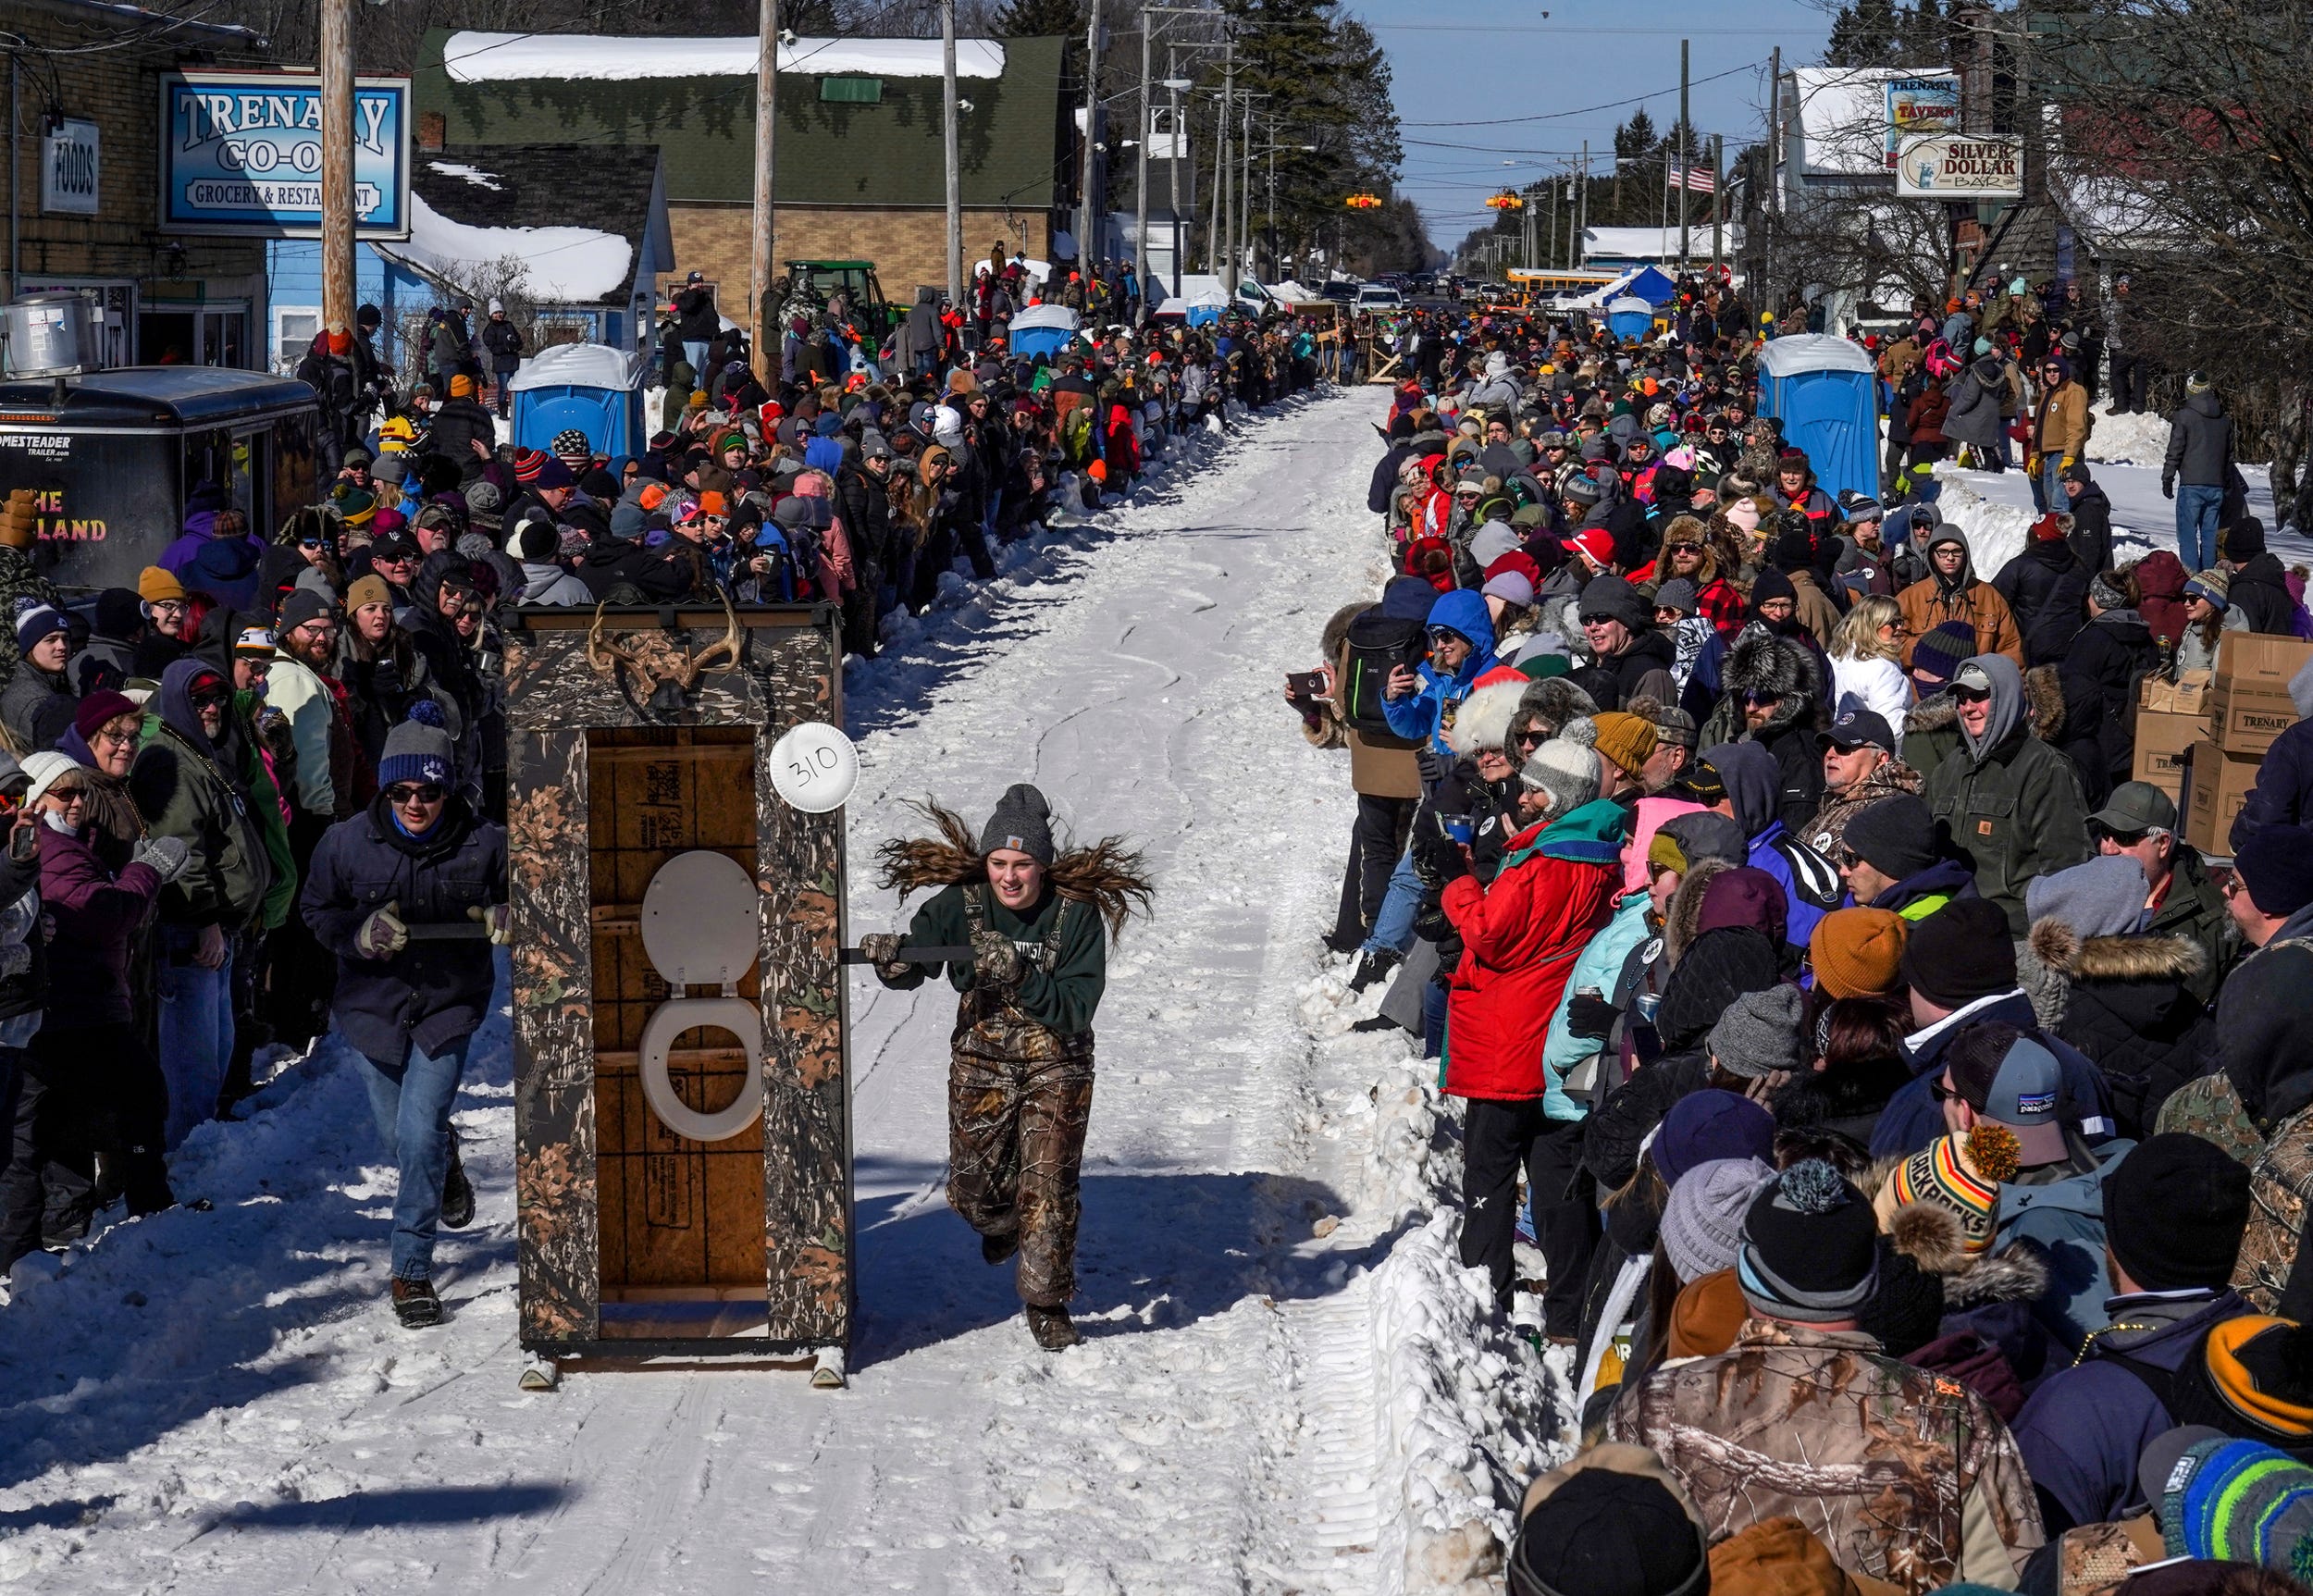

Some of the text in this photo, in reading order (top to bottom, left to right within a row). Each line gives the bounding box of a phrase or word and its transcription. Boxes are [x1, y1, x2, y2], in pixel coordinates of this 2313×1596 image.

[1891, 80, 1953, 91] TRENARY
[1899, 105, 1955, 118] TAVERN
[179, 93, 390, 156] TRENAY
[216, 139, 322, 174] CO-O
[1948, 143, 2011, 158] SILVER
[56, 142, 93, 195] FOODS
[1945, 159, 2016, 174] DOLLAR
[1954, 177, 2004, 187] BAR
[195, 184, 370, 206] GROCERY & RESTANT
[2244, 715, 2289, 729] TRENARY
[789, 747, 838, 787] 310
